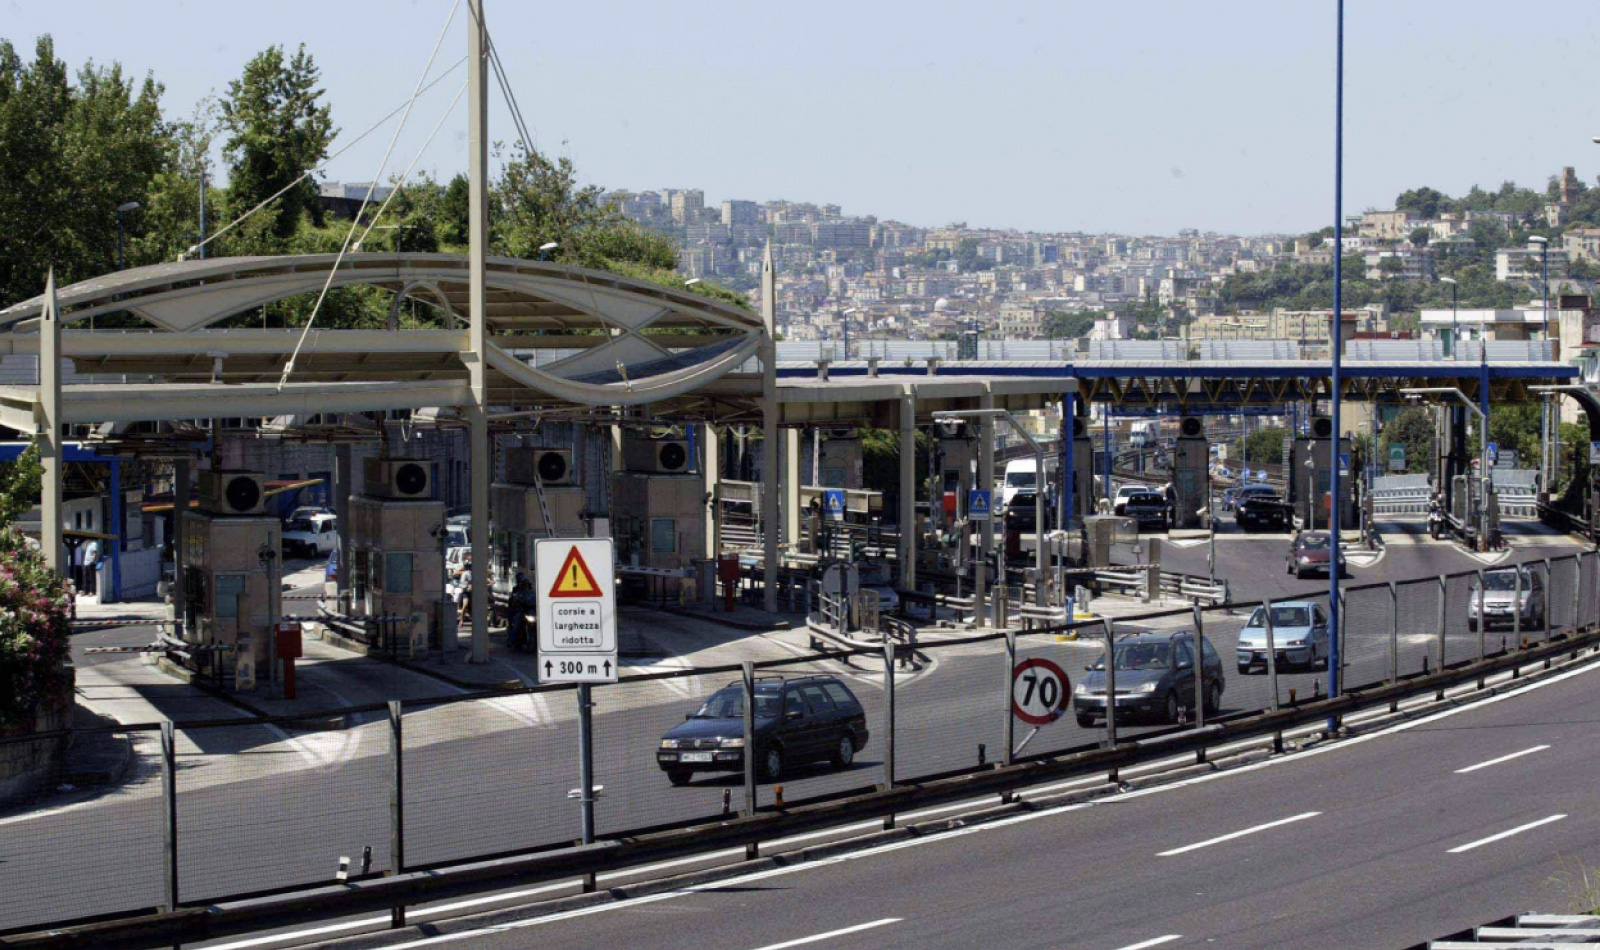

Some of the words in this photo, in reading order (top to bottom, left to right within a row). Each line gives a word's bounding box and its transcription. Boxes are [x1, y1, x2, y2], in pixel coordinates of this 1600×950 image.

[558, 607, 586, 616] corsie
[554, 622, 600, 631] larghezza
[562, 636, 594, 644] ridotta
[560, 661, 583, 675] 300
[588, 664, 597, 674] m
[1022, 675, 1058, 708] 70
